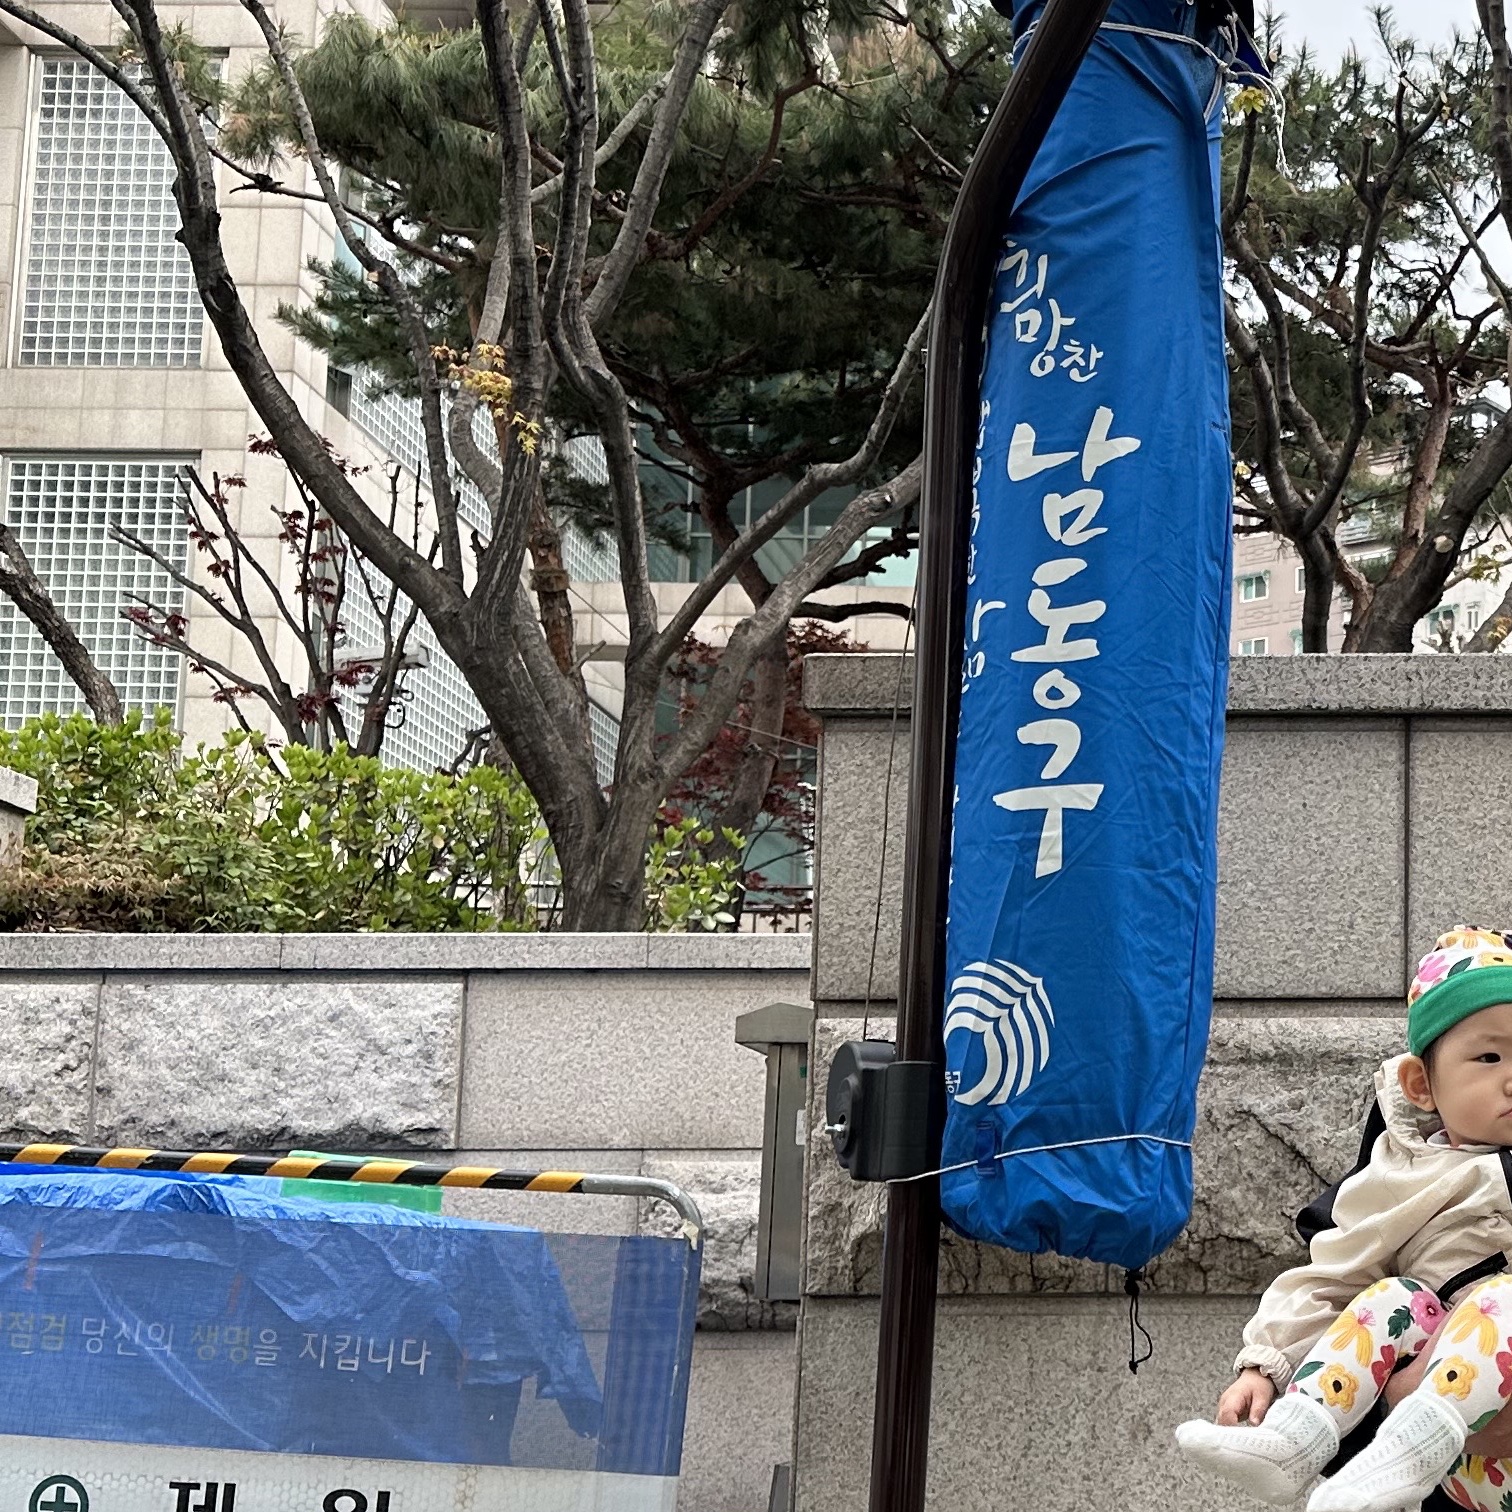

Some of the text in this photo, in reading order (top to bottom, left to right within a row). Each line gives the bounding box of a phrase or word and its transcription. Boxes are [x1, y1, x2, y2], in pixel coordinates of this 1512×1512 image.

[992, 405, 1141, 878] 남동구
[0, 1311, 432, 1376] 점검 당신의 생명을 지킵니다
